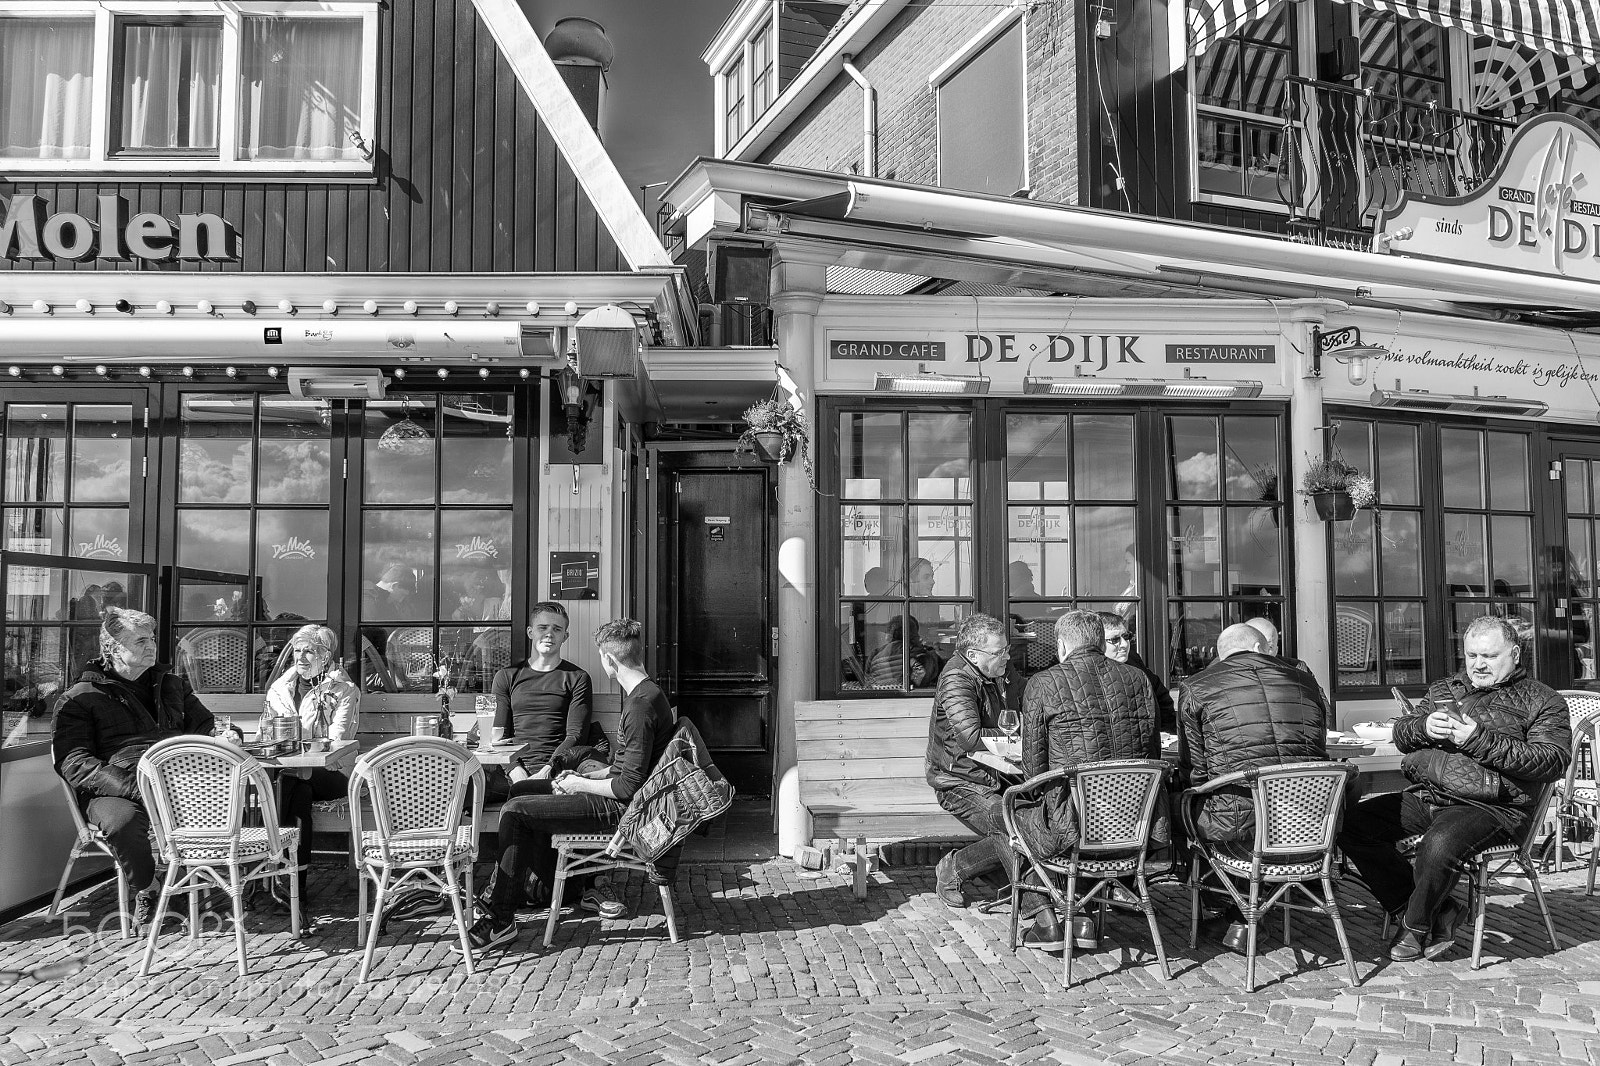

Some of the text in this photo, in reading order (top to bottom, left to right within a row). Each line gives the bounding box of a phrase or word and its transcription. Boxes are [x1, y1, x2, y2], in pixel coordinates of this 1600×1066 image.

[1501, 190, 1533, 204] GRAND
[1434, 217, 1464, 236] sinds
[1487, 205, 1538, 248] DE
[837, 343, 939, 357] GRAND CAFE
[964, 334, 1146, 372] DE DIJK
[1175, 347, 1267, 361] RESTAURANT
[1384, 348, 1404, 363] wie
[1407, 350, 1494, 372] volmaaktheid
[1495, 359, 1531, 375] zoekt
[1532, 362, 1543, 379] is
[1533, 363, 1579, 388] gelijk
[1580, 372, 1599, 382] een
[1018, 519, 1031, 528] DE
[79, 533, 123, 557] De Molen
[272, 536, 316, 560] De Molen
[455, 535, 499, 559] De Molen
